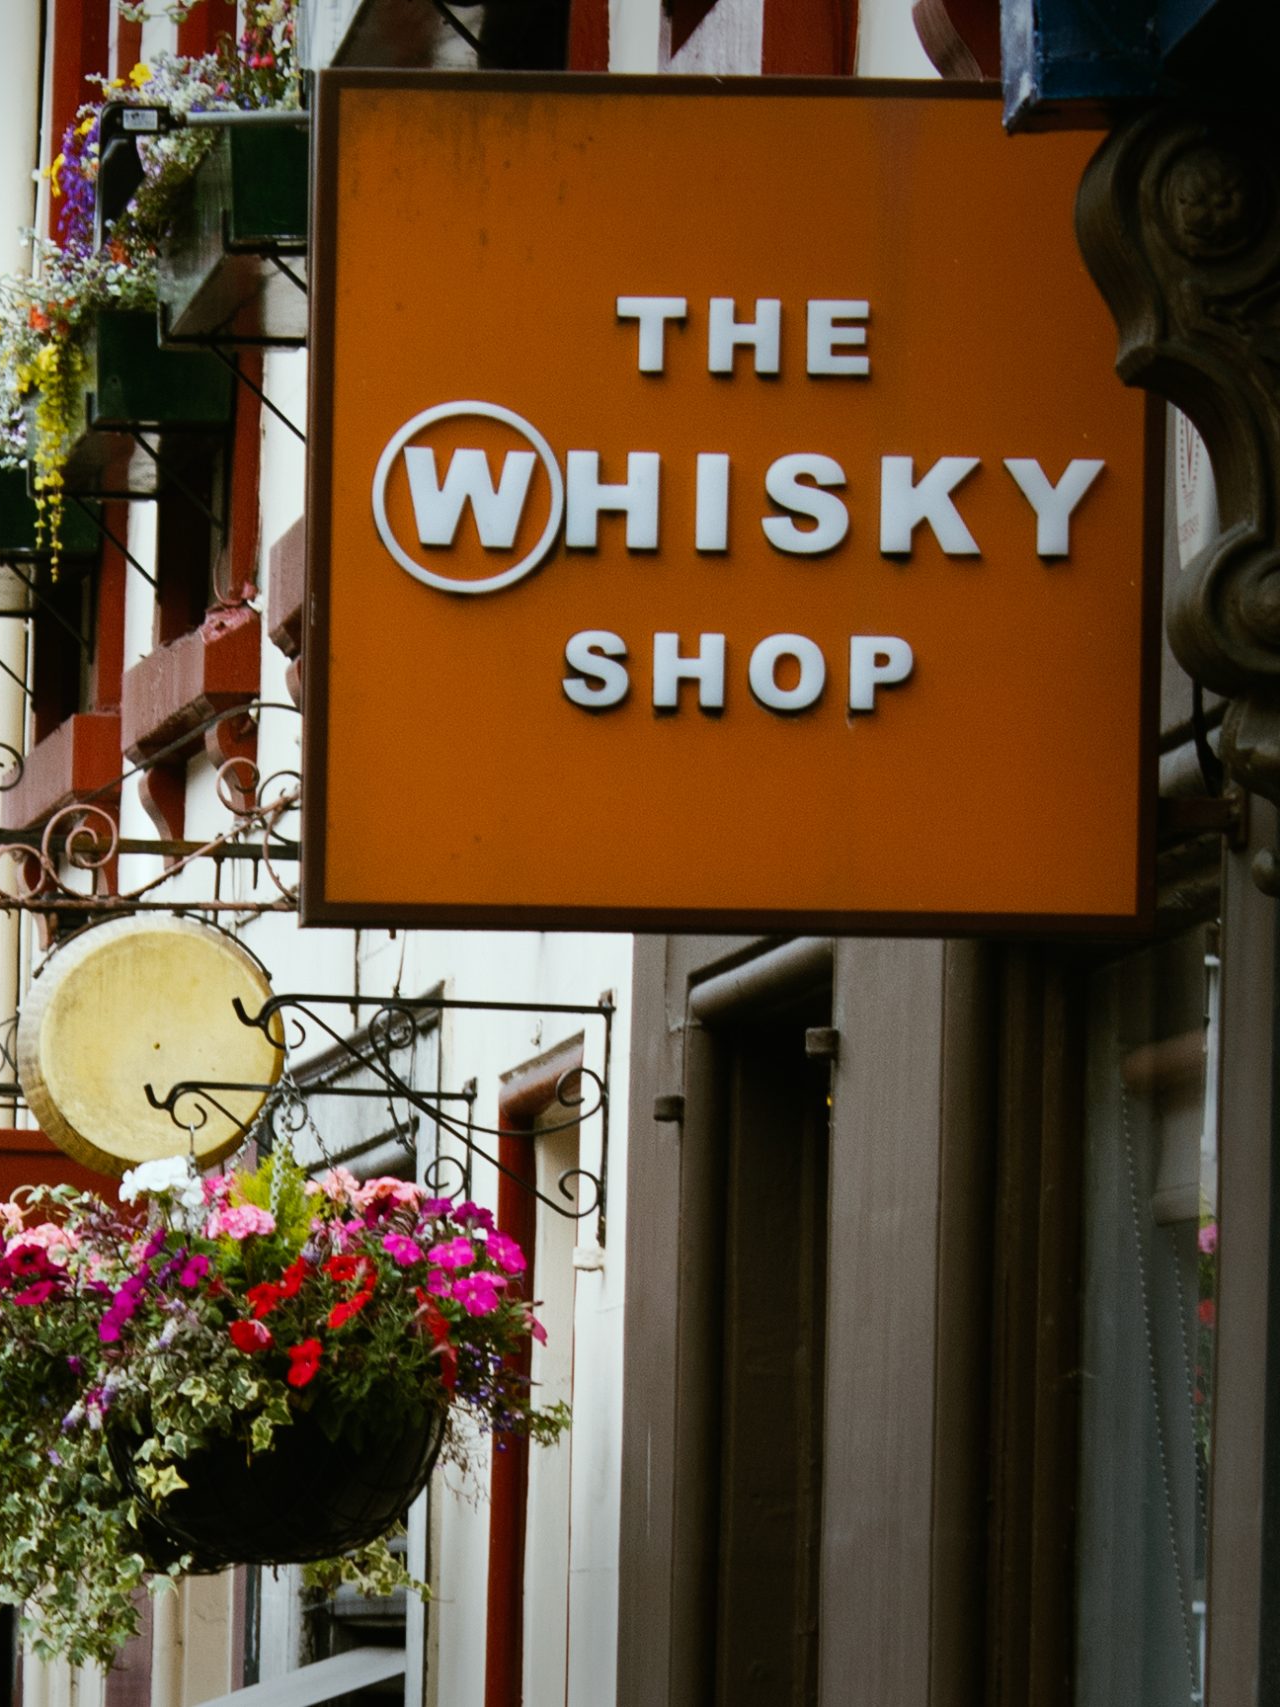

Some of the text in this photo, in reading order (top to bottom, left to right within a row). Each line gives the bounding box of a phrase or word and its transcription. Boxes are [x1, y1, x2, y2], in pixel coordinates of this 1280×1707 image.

[616, 296, 870, 375] THE
[402, 445, 1106, 556] WHISKY
[562, 629, 914, 711] SHOP
